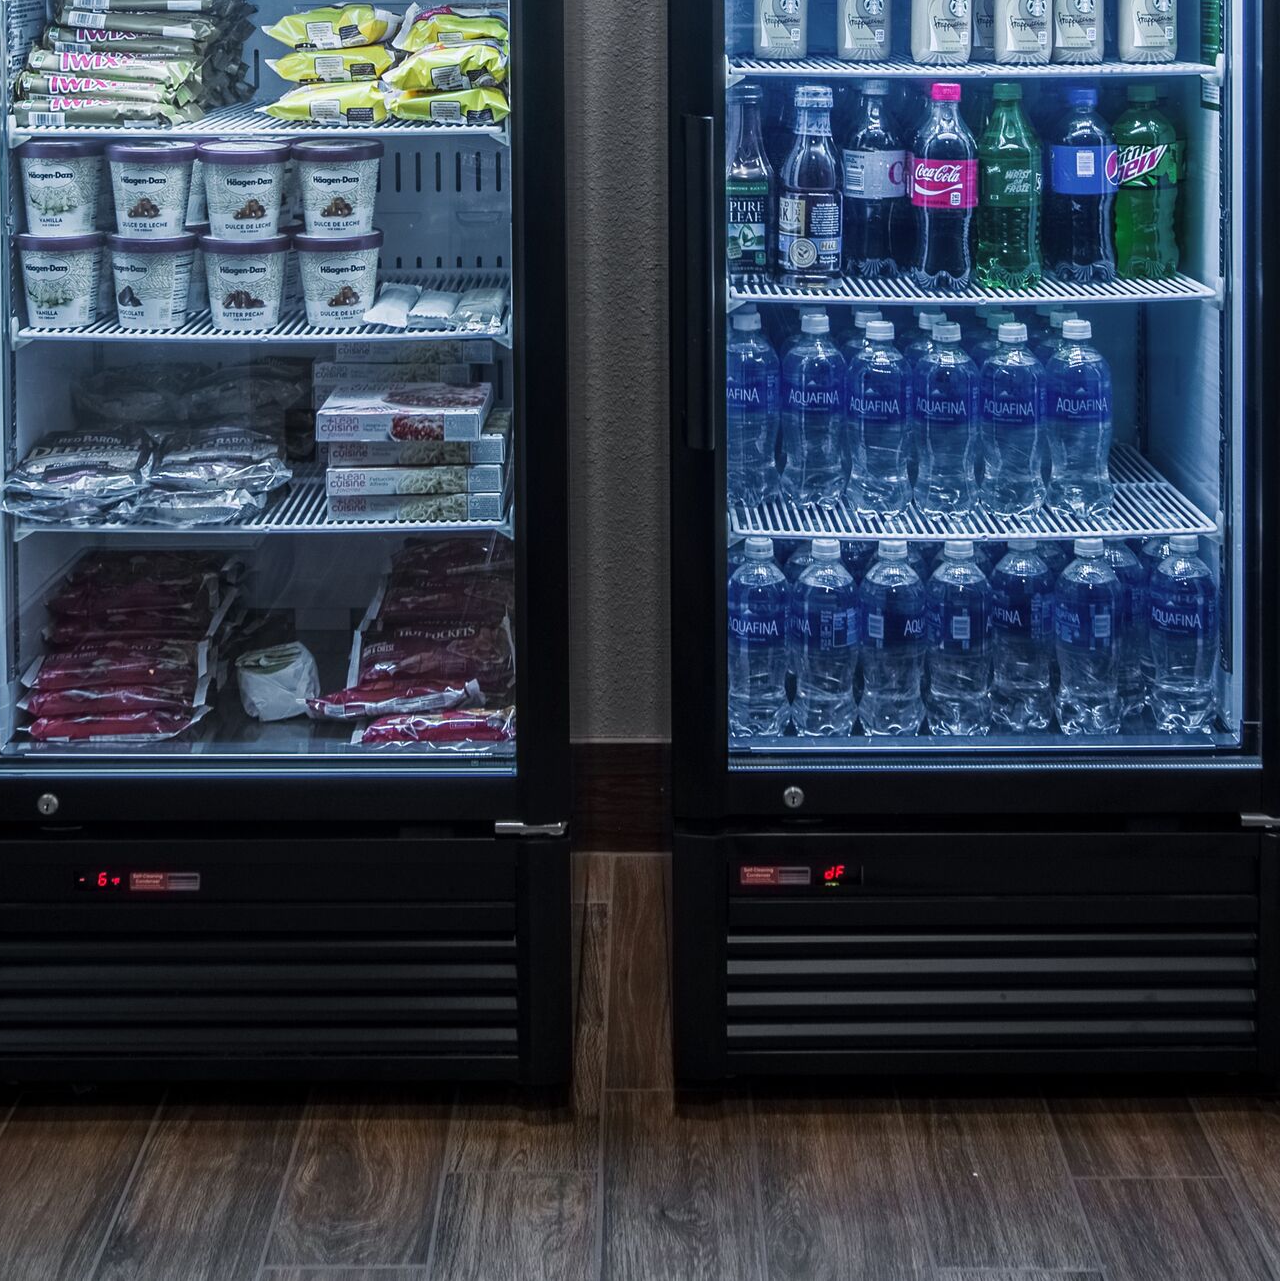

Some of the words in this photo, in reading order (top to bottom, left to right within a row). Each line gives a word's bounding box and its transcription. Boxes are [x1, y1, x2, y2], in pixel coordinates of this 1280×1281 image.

[60, 51, 120, 72] TWIX
[50, 76, 112, 95] TWIX
[28, 171, 74, 181] Häagen-Dazs
[915, 163, 963, 183] Coca-Cola
[121, 175, 167, 186] Häagen-Dazs
[226, 177, 273, 188] Häagen-Dazs
[313, 175, 360, 186] Häagen-Dazs
[729, 201, 765, 212] PURE
[729, 212, 762, 223] LEAF
[220, 266, 267, 276] Häagen-Dazs
[320, 264, 366, 275] Häagen-Dazs
[726, 388, 760, 403] AFINA
[788, 389, 840, 405] AQUAFINA
[849, 397, 901, 414] AQUAFINA
[916, 397, 967, 416] AQUAFINA
[983, 398, 1035, 416] AQUAFINA
[1056, 397, 1108, 414] AQUAFINA
[320, 422, 360, 432] cuisine
[330, 478, 366, 488] cuisine
[331, 502, 367, 512] cuisine
[1151, 606, 1202, 629] AQUAFINA
